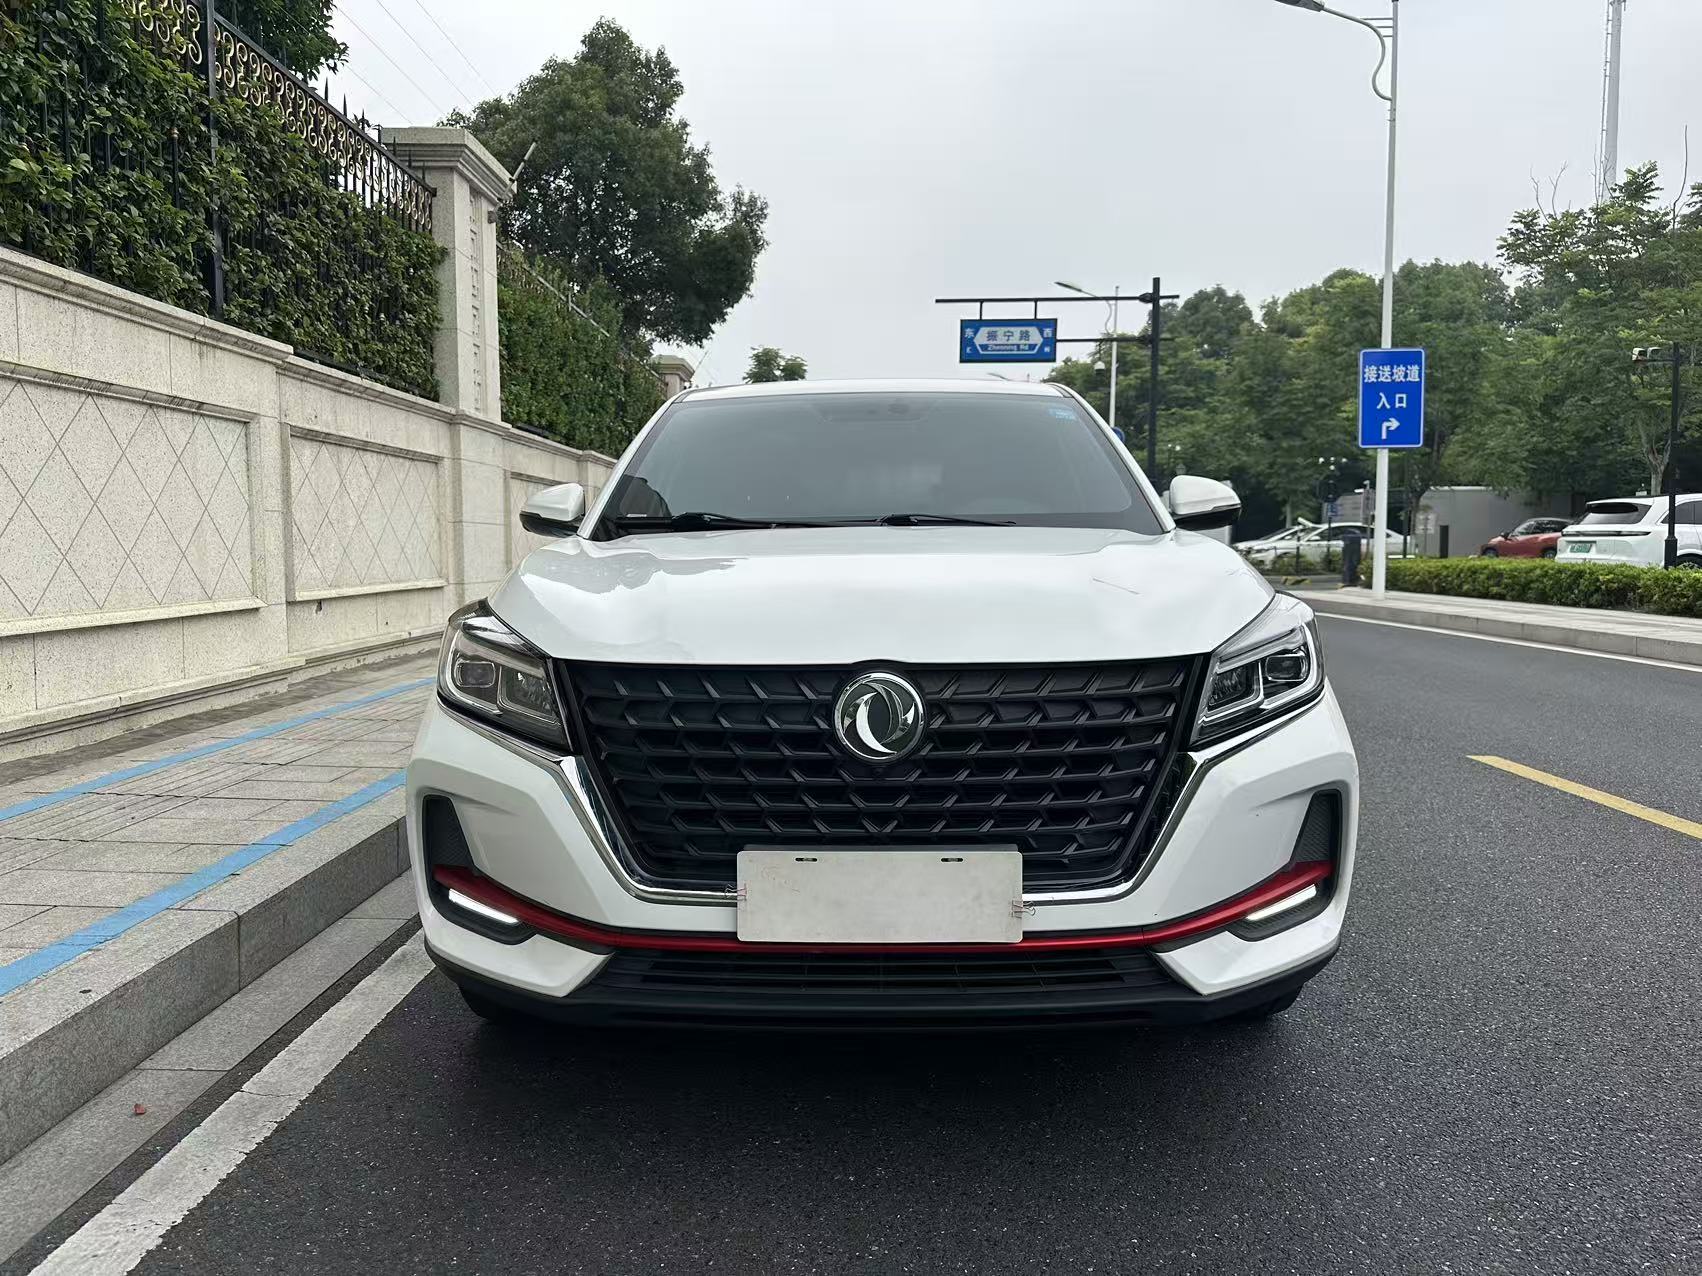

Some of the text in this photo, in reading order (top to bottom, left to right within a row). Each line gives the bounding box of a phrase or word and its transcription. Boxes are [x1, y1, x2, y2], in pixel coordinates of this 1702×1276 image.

[986, 330, 1031, 342] 振宁路
[1364, 365, 1420, 382] 接送坡道
[1376, 392, 1407, 409] 入口
